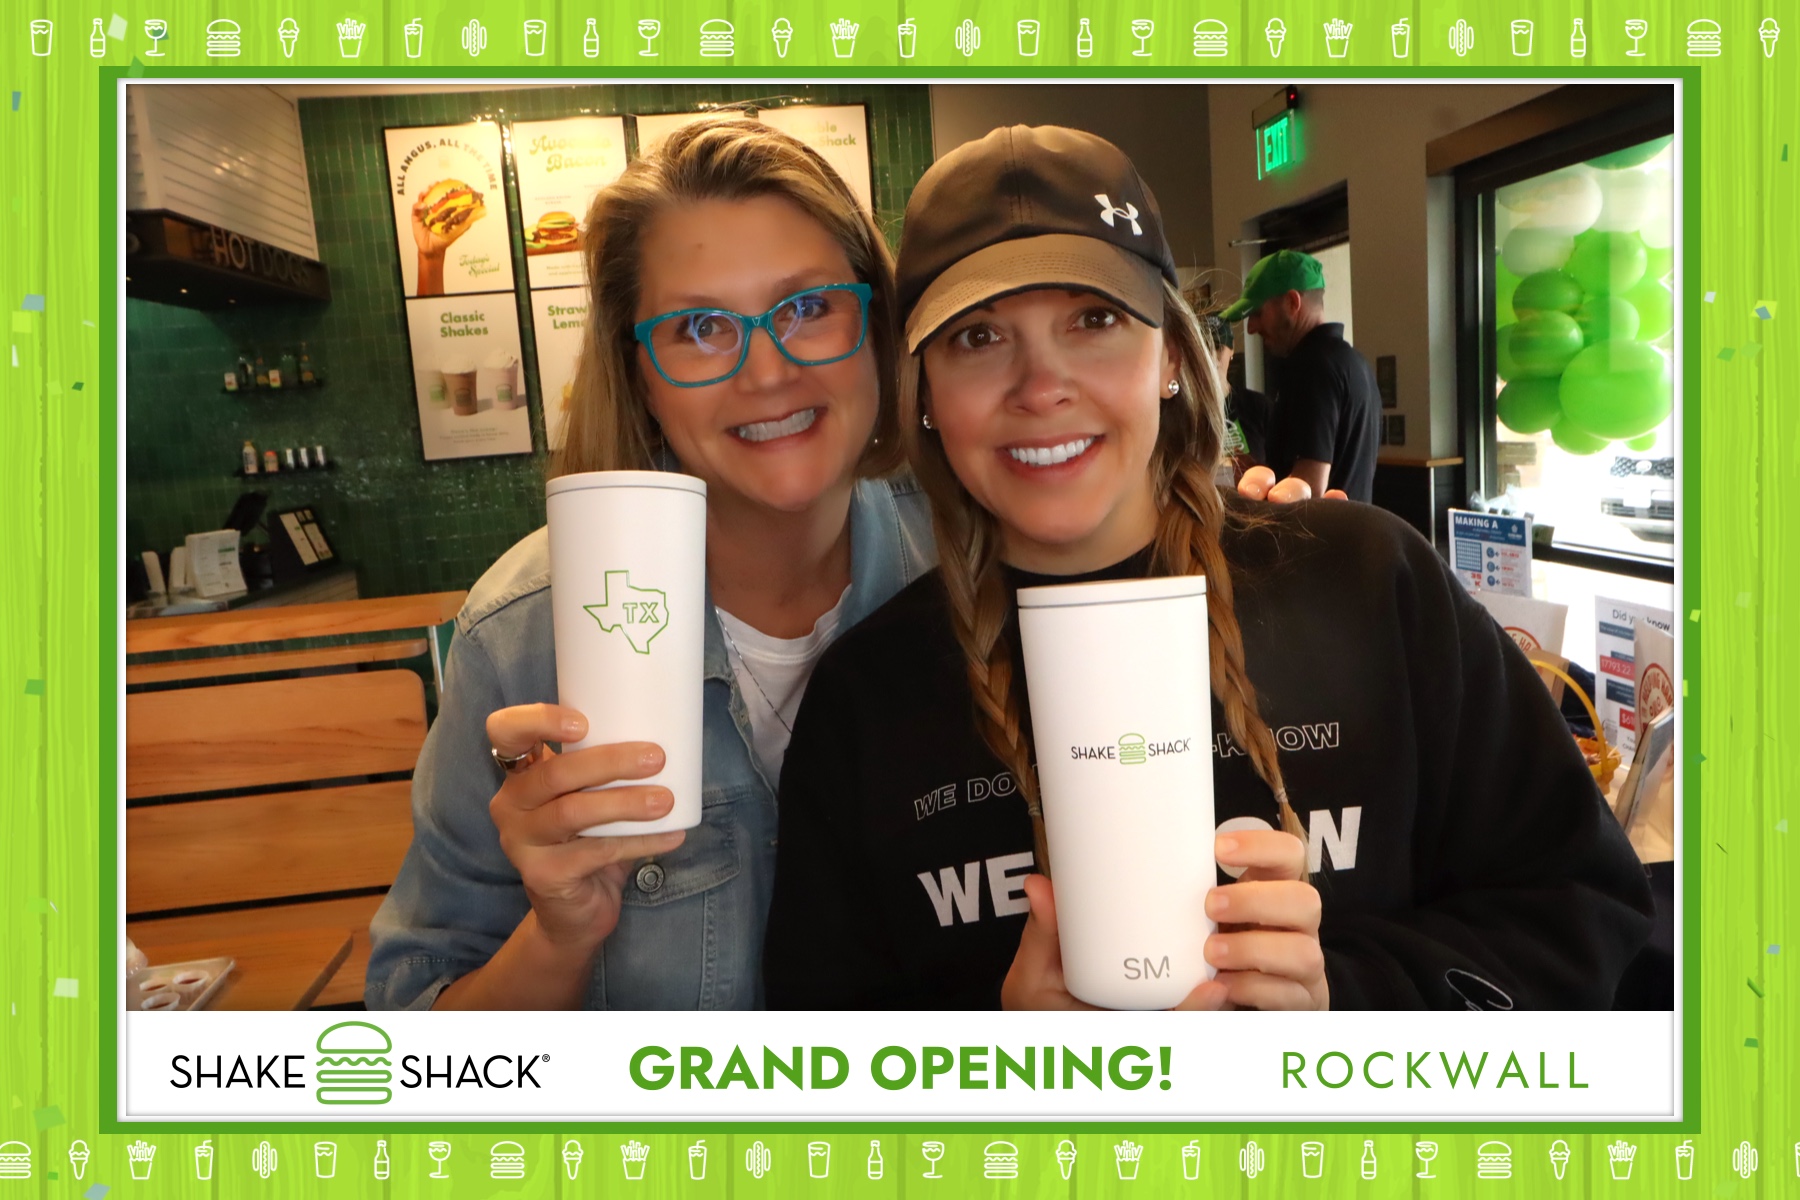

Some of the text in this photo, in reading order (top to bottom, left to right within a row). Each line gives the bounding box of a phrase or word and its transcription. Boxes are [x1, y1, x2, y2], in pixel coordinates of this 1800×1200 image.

[1263, 117, 1288, 172] EXIT
[397, 175, 405, 196] ALL
[439, 138, 460, 148] ALL
[483, 162, 498, 190] TIME
[546, 153, 607, 173] Bacon
[210, 225, 256, 273] HOT
[440, 310, 486, 325] Classic
[552, 318, 585, 330] Lem
[440, 325, 489, 339] Shakes
[1454, 516, 1499, 529] MAKING A
[622, 602, 660, 624] TX
[1612, 609, 1627, 621] Did
[1071, 738, 1191, 760] SHAKE SHACK
[914, 783, 957, 821] WE
[917, 851, 1035, 927] WE
[1123, 955, 1170, 980] SM
